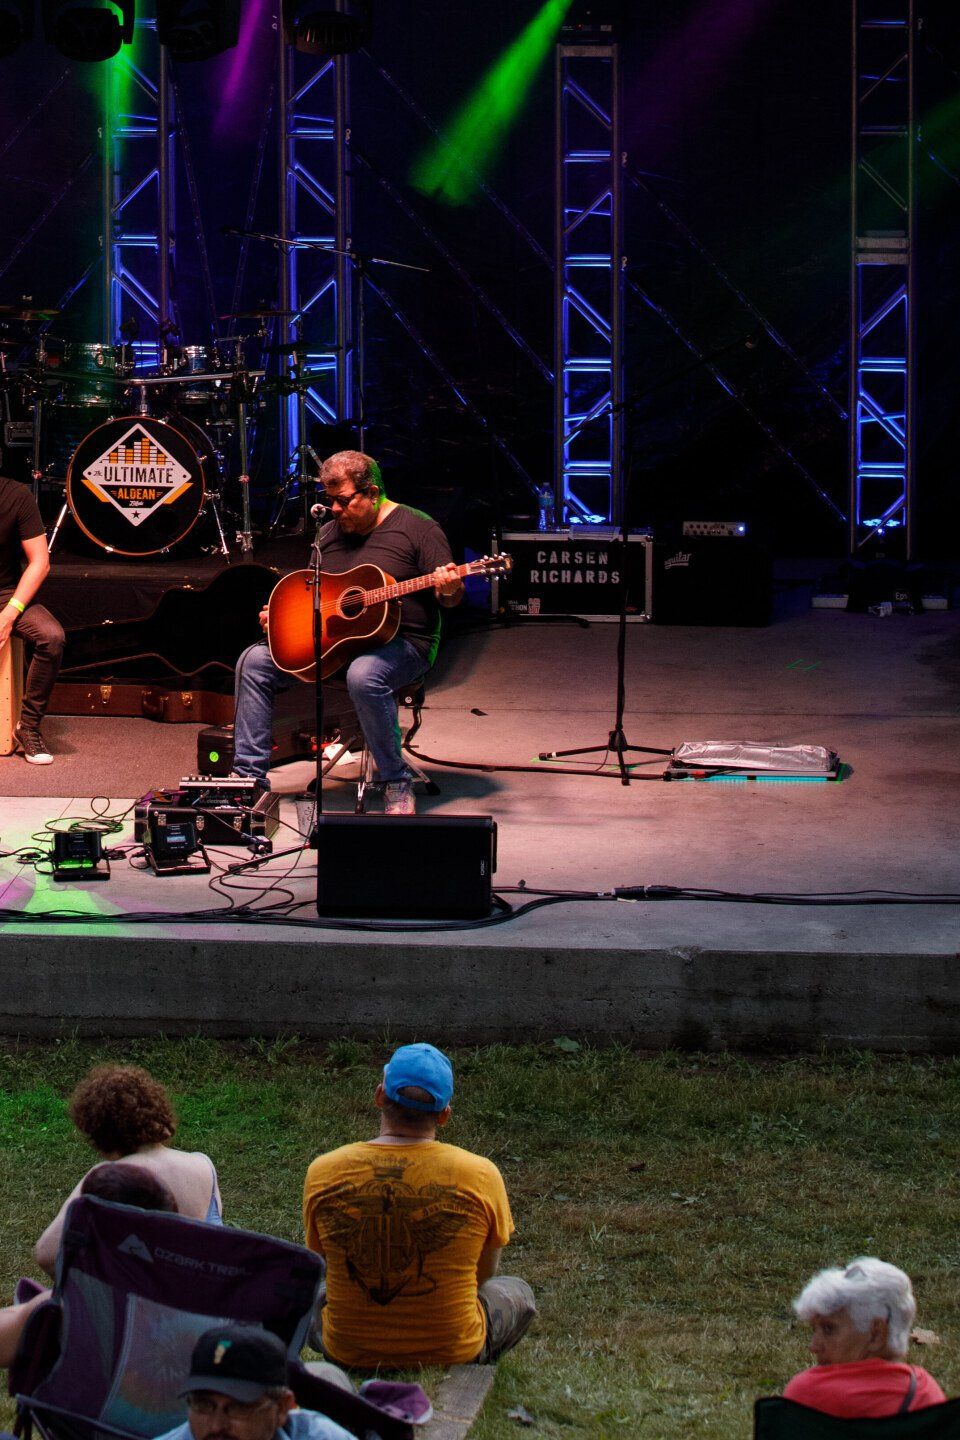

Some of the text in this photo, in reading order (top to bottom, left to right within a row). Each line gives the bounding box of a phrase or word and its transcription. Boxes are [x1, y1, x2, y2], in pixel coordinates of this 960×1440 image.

[104, 466, 174, 484] ULTIMATE
[117, 487, 156, 500] ALDEAN
[536, 550, 609, 565] CARSEN
[530, 569, 620, 585] RICHARDS
